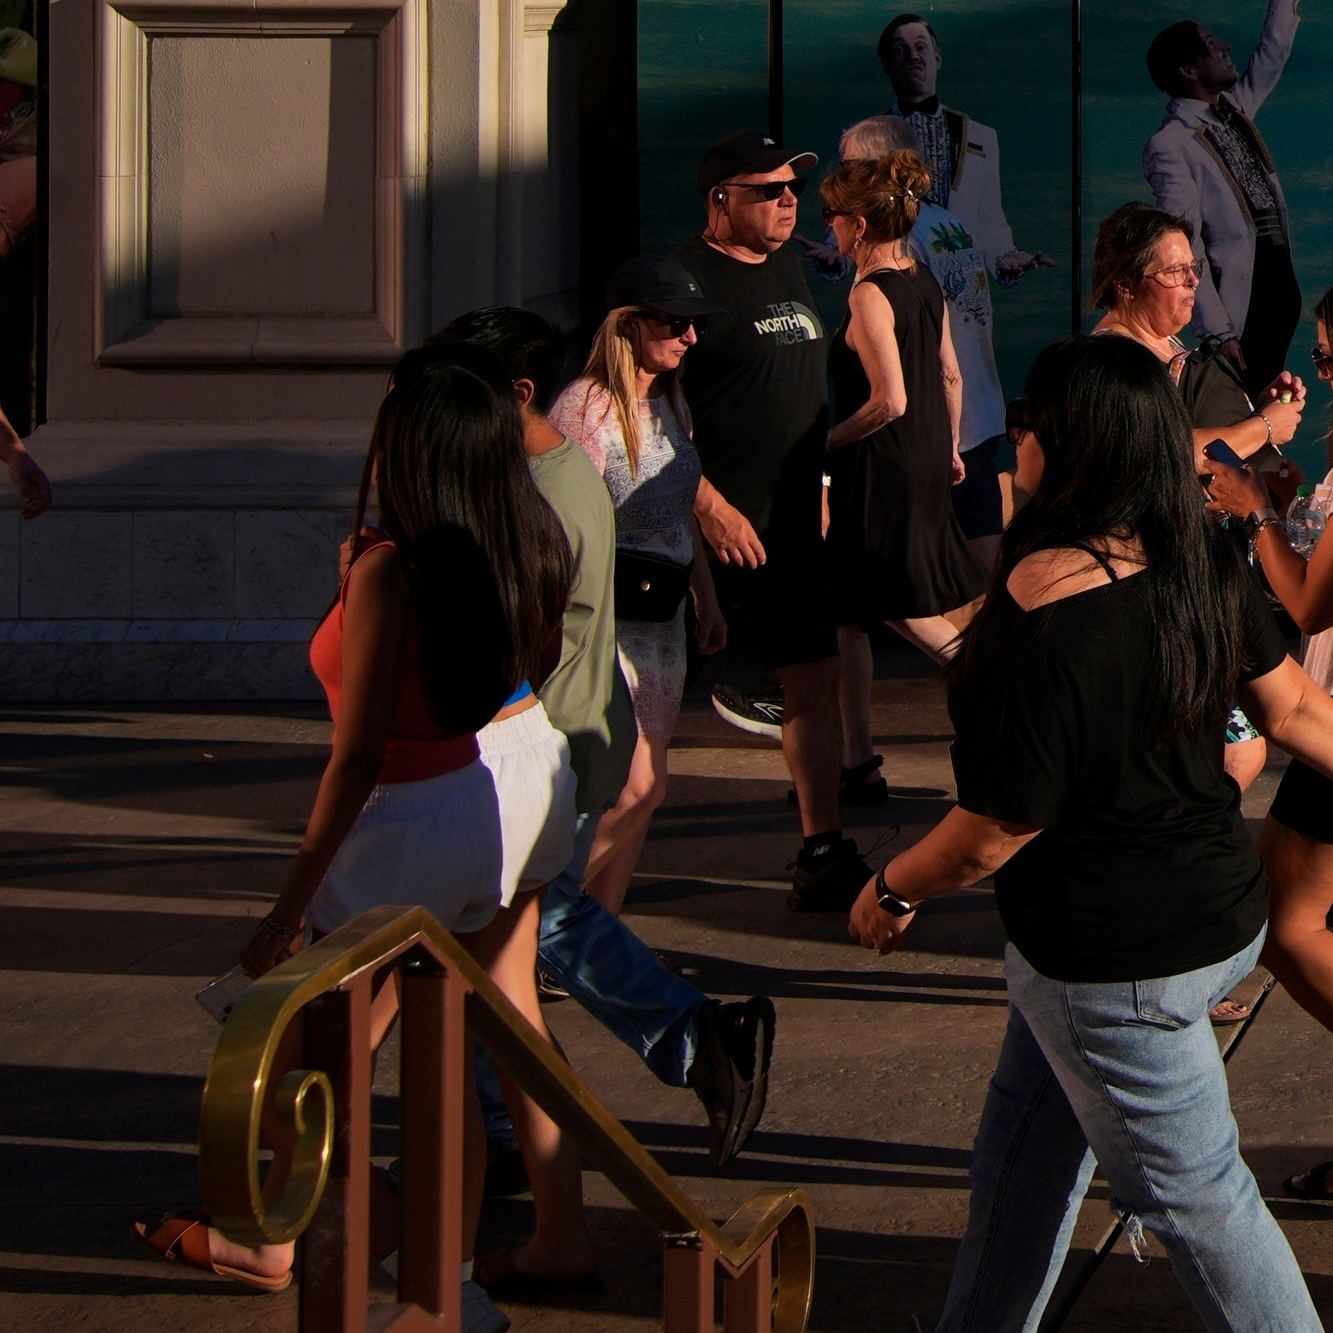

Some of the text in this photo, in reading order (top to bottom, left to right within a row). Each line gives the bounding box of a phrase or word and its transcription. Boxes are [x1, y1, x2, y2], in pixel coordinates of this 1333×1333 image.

[766, 301, 795, 317] THE
[753, 314, 800, 335] NORTH
[775, 328, 804, 346] FACE
